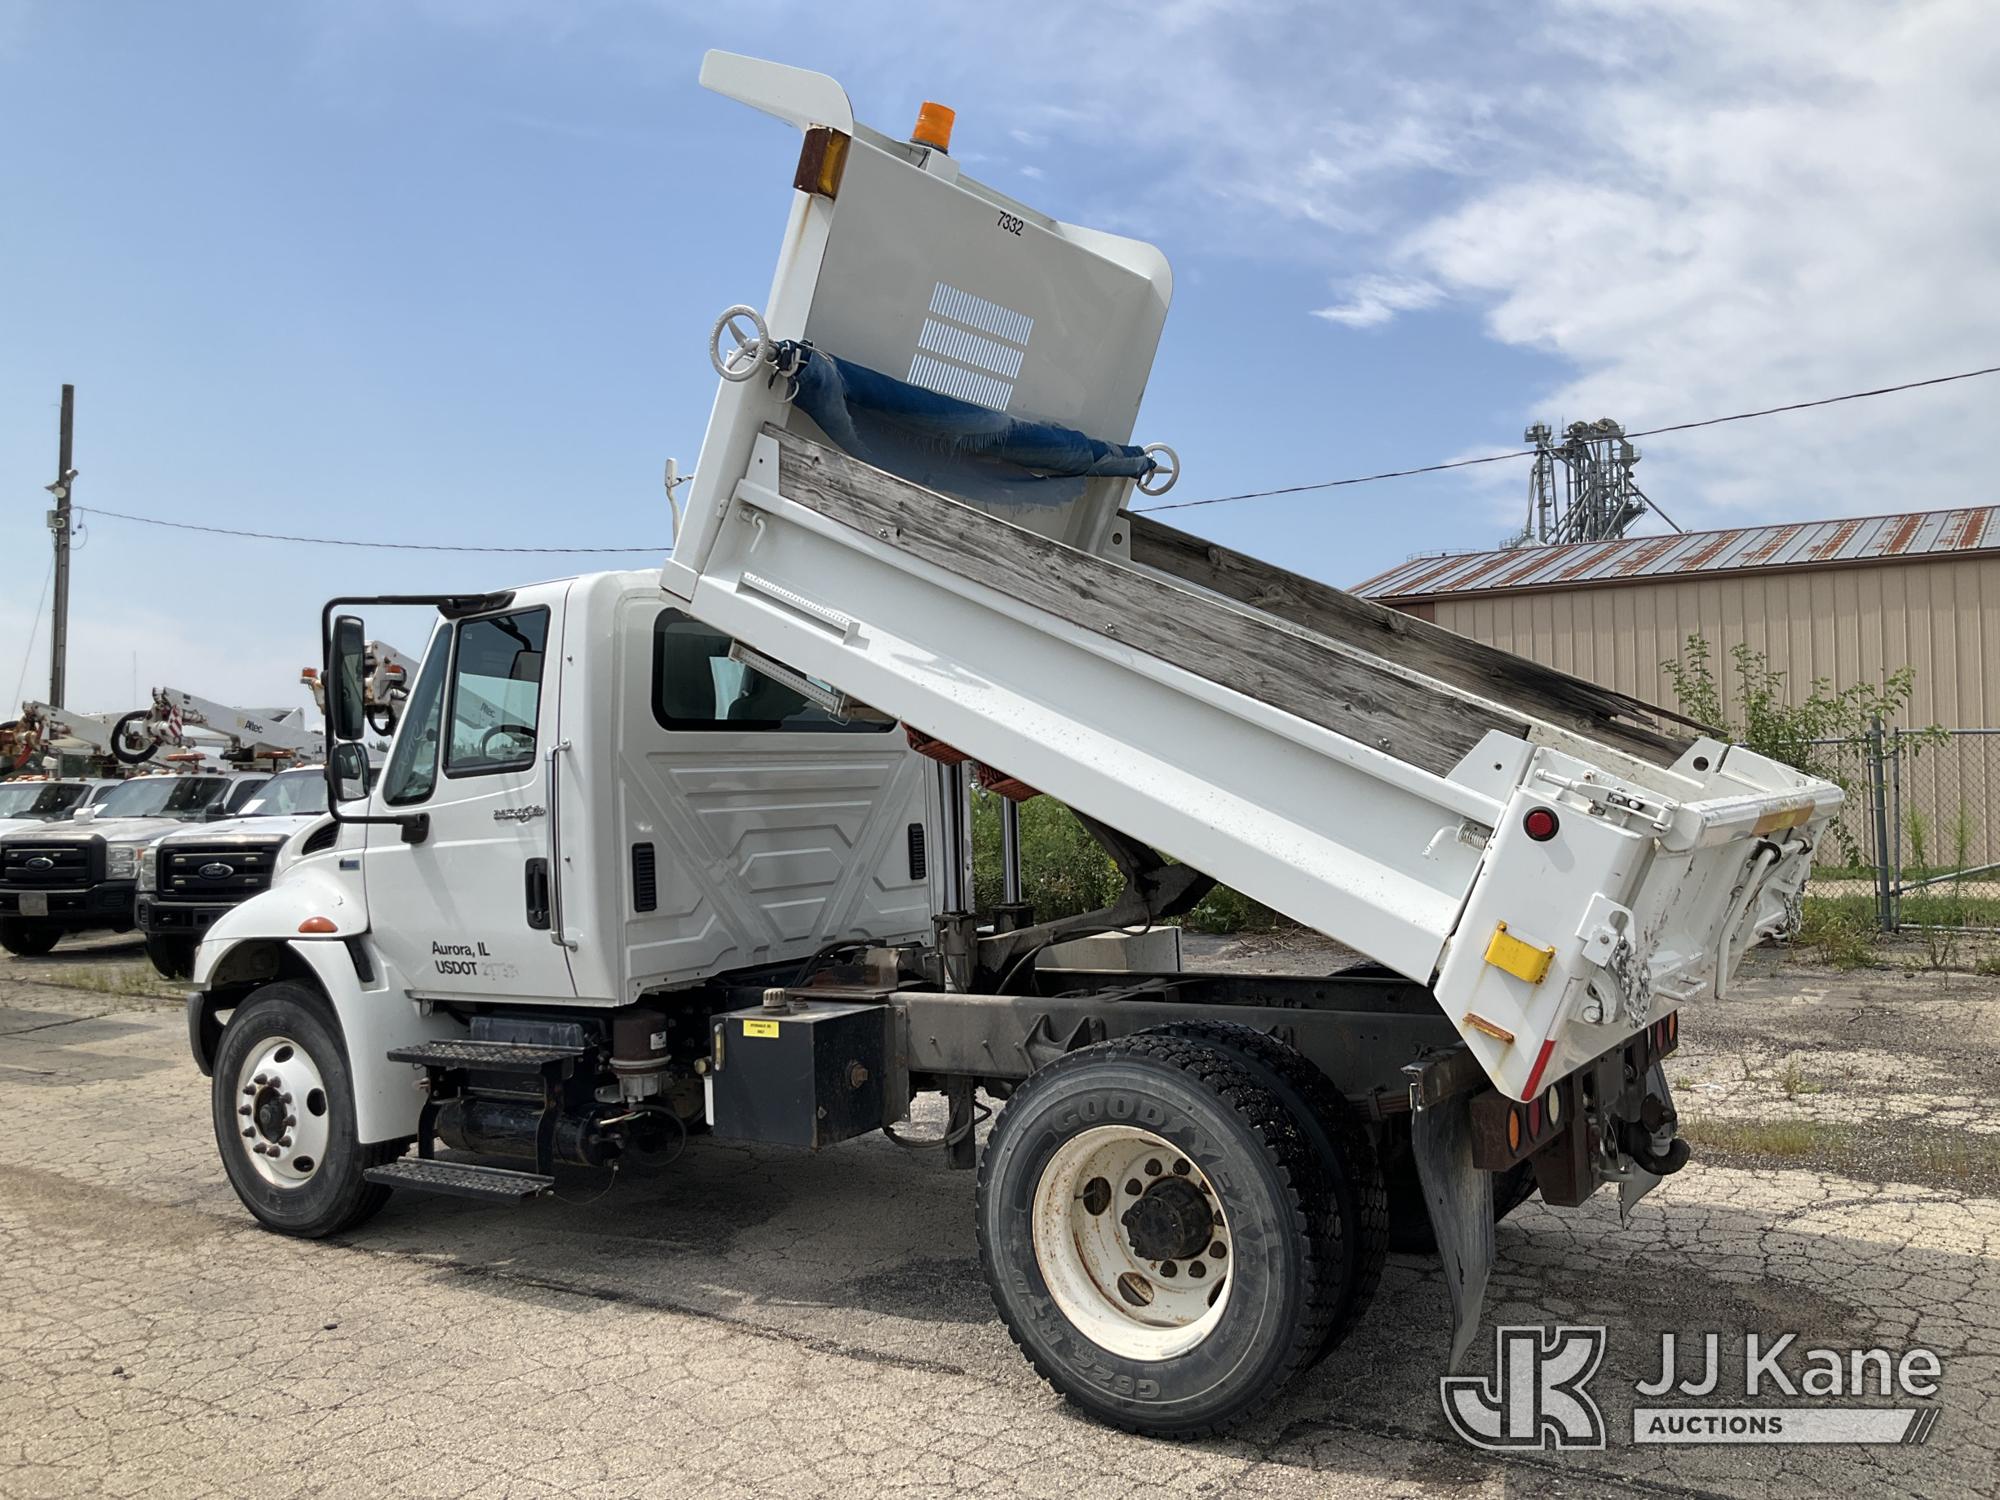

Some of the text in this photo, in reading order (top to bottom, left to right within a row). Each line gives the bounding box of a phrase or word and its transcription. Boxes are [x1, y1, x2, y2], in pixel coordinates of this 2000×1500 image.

[997, 210, 1024, 236] 7332
[432, 940, 491, 958] Aurora, IL
[434, 960, 478, 976] USDOT
